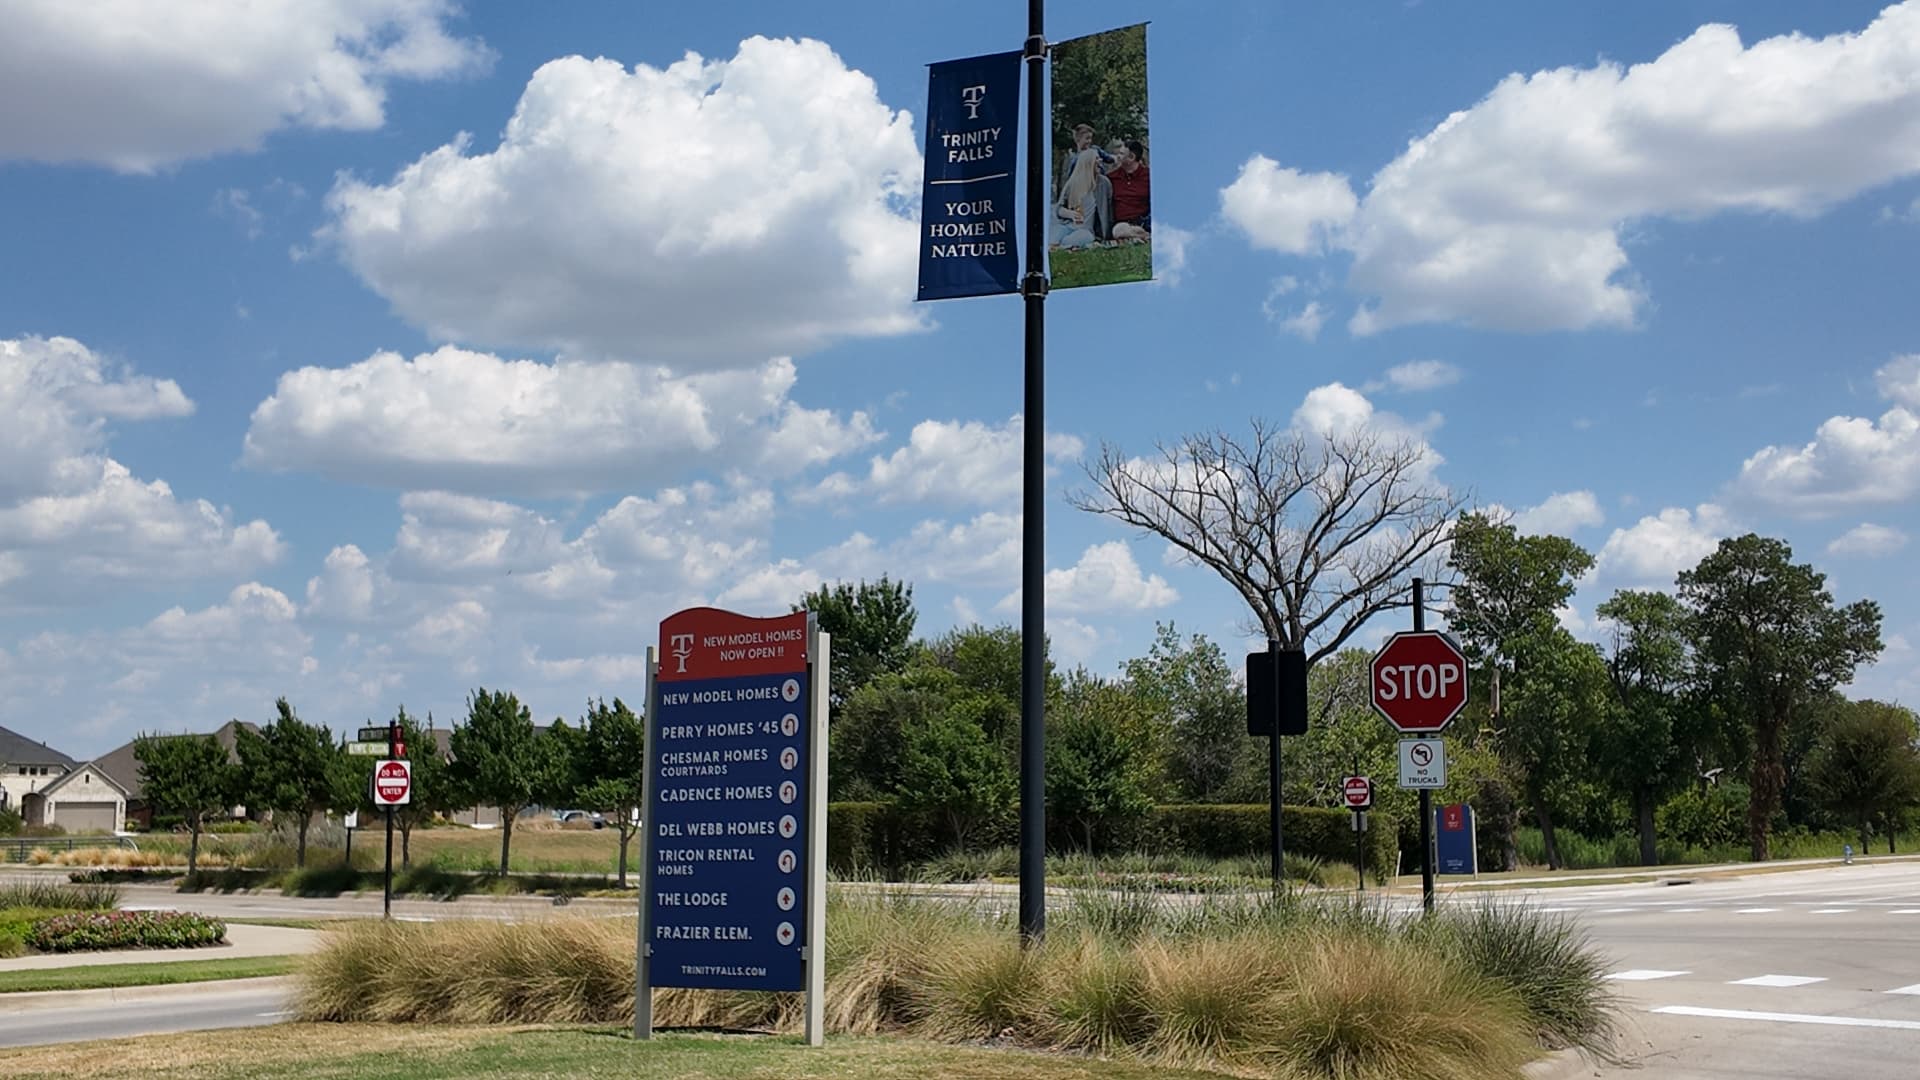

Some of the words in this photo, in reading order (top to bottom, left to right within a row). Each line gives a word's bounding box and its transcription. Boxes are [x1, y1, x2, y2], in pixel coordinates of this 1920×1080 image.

[941, 127, 1001, 147] TRINITY
[948, 145, 994, 163] FALLS
[945, 199, 994, 216] YOUR
[930, 222, 985, 238] HOME
[989, 219, 1006, 235] IN
[931, 241, 1007, 258] NATURE
[703, 635, 727, 648] NEW
[728, 631, 764, 646] MODEL
[766, 629, 803, 642] HOMES
[720, 649, 747, 661] NOW
[1379, 663, 1459, 701] STOP
[663, 693, 689, 706] NEW
[693, 689, 733, 704] MODEL
[736, 686, 779, 701] HOMES
[662, 724, 703, 740] PERRY
[707, 722, 754, 737] HOMES
[661, 750, 720, 765] CHESMAR
[724, 748, 768, 762] HOMES
[381, 769, 391, 777] DO
[392, 769, 405, 777] NOT
[661, 765, 728, 777] COURTYARDS
[1408, 777, 1438, 785] TRUCKS
[381, 787, 402, 796] ENTER
[660, 787, 721, 802] CADENCE
[725, 786, 773, 800] HOMES
[659, 823, 683, 836] DEL
[687, 822, 723, 836] WEBB
[728, 821, 775, 835] HOMES
[658, 849, 704, 861] TRICON
[707, 848, 755, 861] RENTAL
[657, 865, 694, 875] HOMES
[657, 892, 681, 906] THE
[684, 892, 728, 906] LODGE
[656, 926, 711, 940] FRAZIER
[714, 927, 752, 940] ELEM.
[681, 965, 767, 977] TRINITYFALLS.COM
